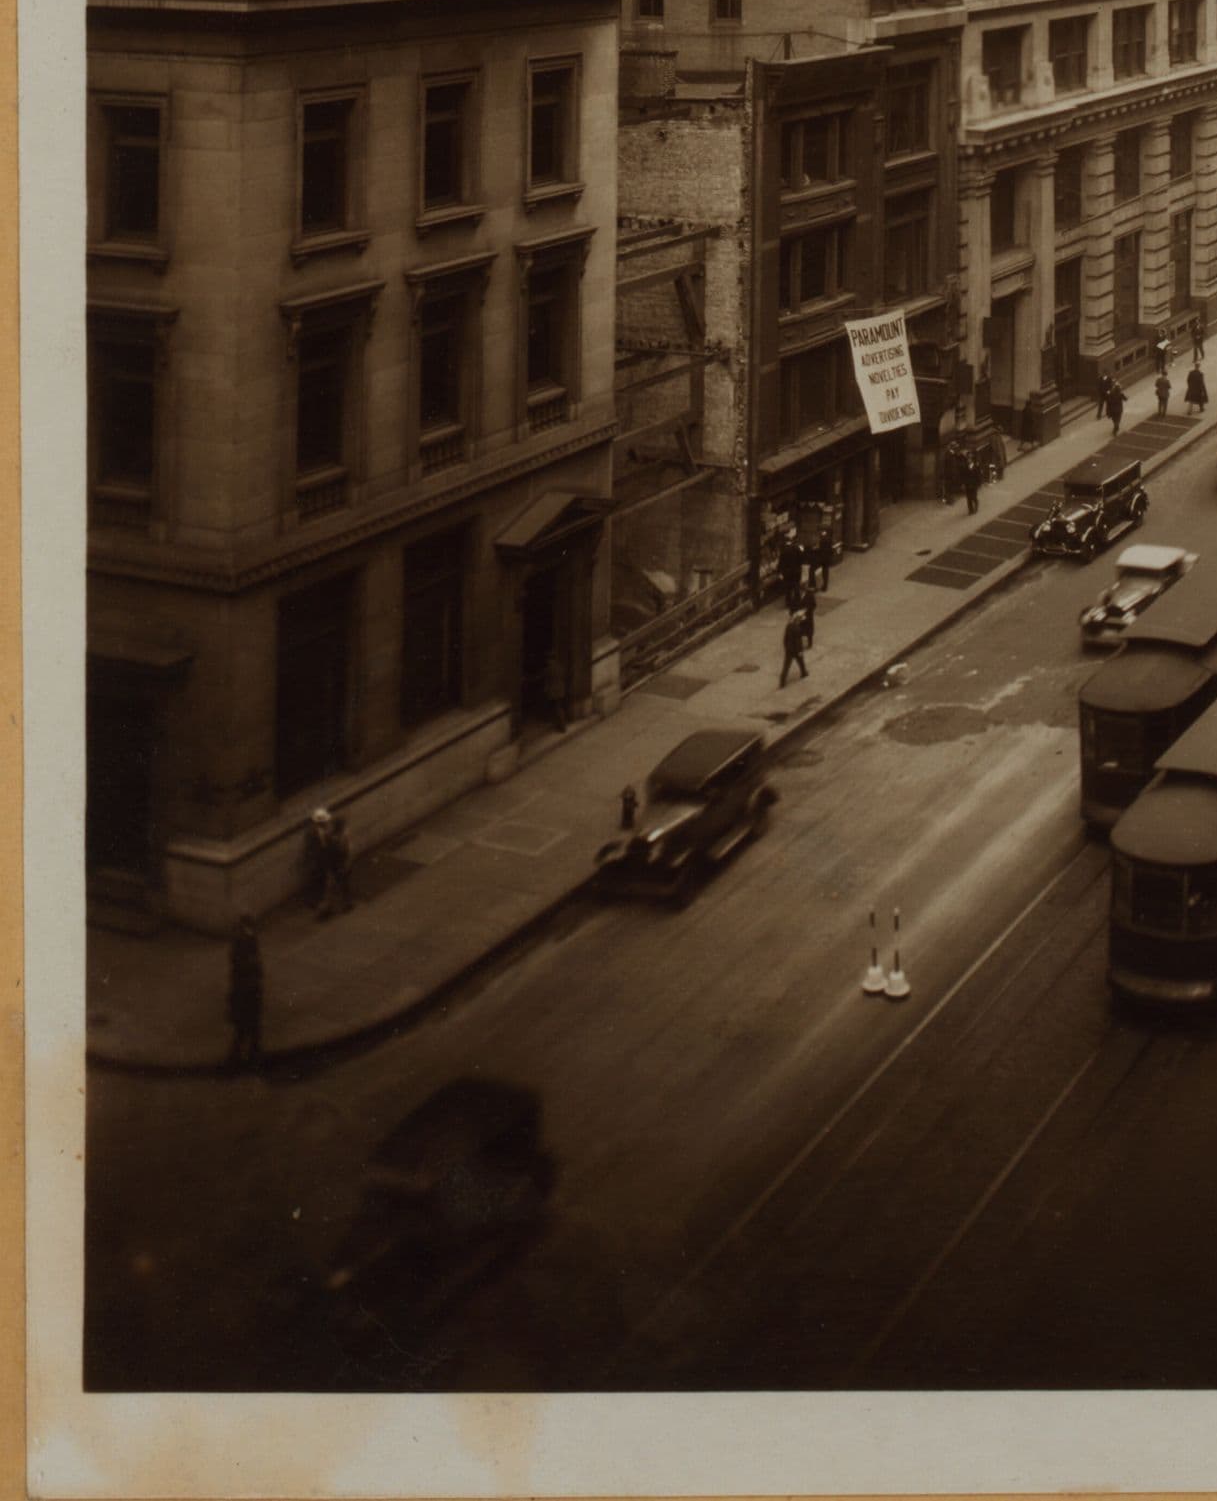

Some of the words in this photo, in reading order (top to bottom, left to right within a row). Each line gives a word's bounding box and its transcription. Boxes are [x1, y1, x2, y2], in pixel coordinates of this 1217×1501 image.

[850, 317, 904, 347] PARAMOUNT
[861, 344, 904, 366] ADVERTISING
[868, 364, 908, 384] NOVELTIES
[886, 387, 900, 402] PAY
